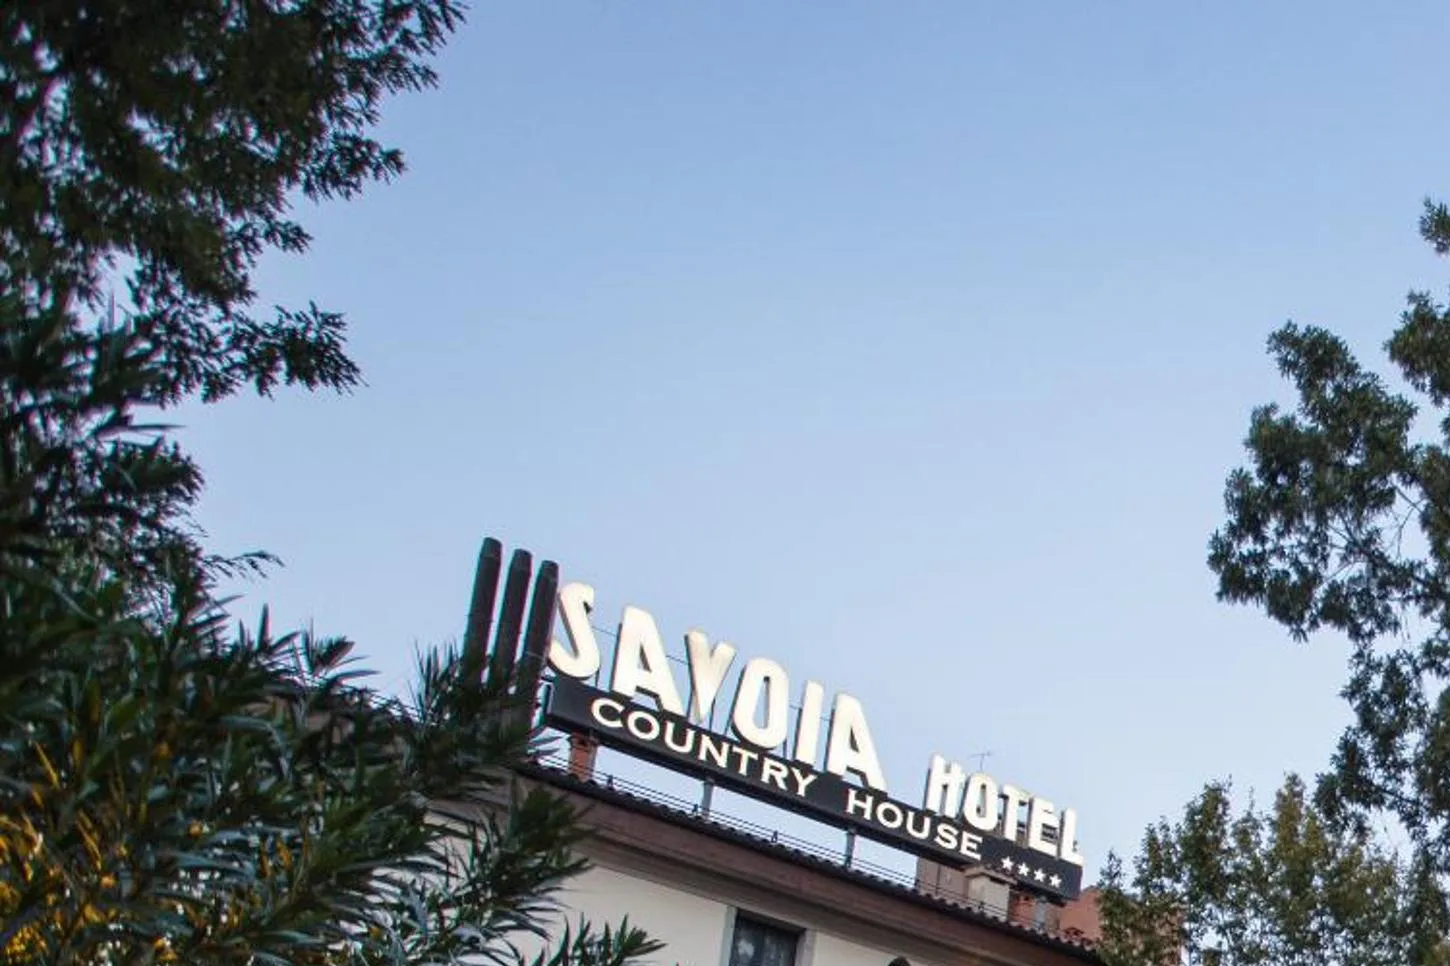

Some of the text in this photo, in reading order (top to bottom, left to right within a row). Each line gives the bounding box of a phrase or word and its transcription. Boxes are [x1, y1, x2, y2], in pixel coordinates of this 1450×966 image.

[549, 581, 1084, 867] SAVOIA HOTEL
[591, 697, 984, 861] COUNTRY HOUSE
